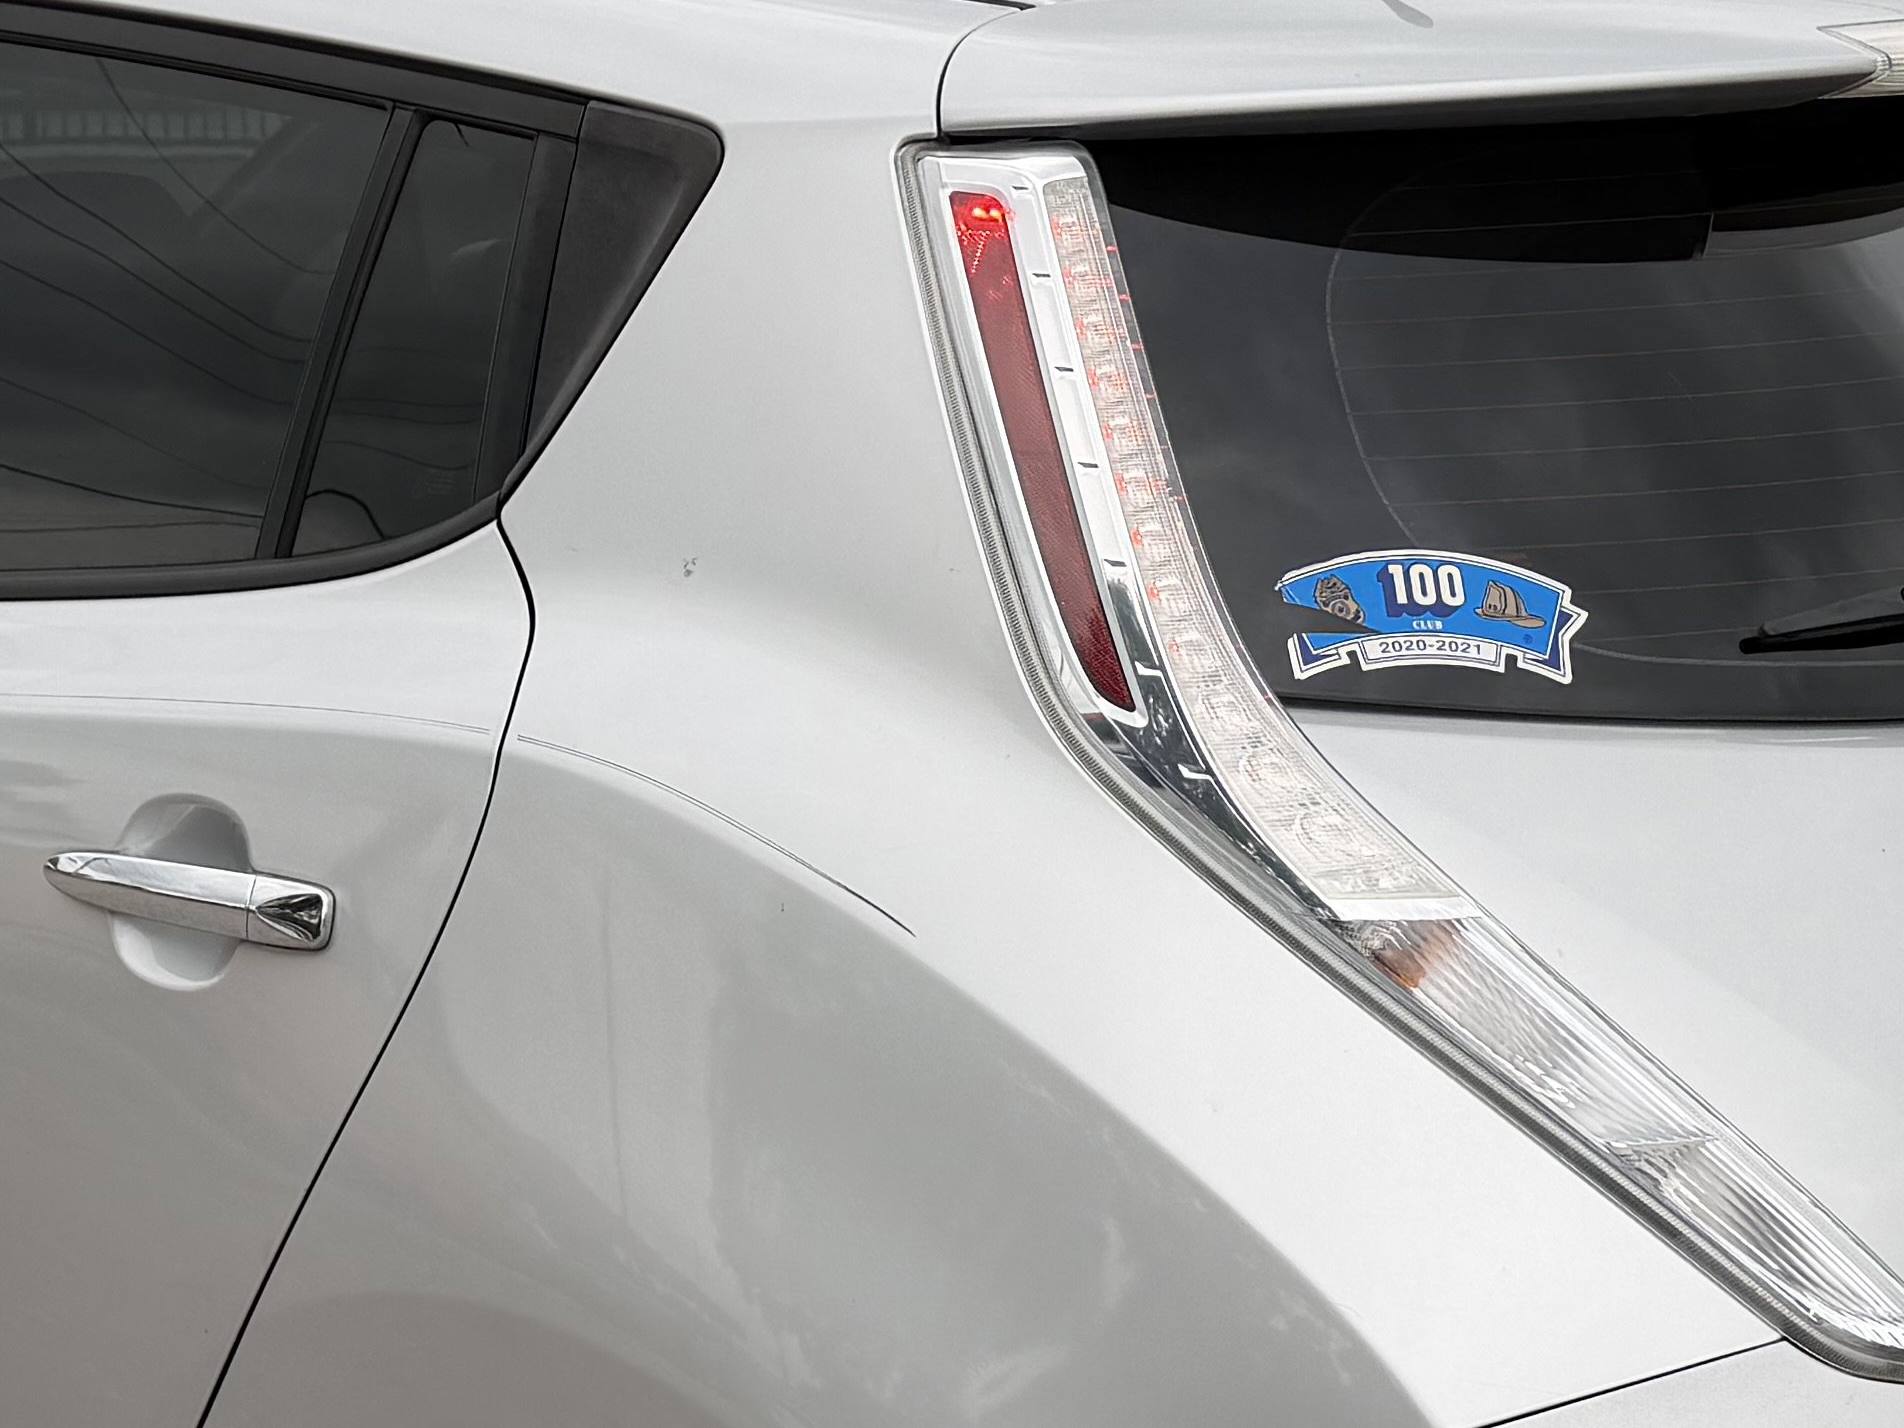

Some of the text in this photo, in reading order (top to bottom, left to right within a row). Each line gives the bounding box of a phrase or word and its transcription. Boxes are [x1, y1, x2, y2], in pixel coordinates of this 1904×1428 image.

[1381, 562, 1465, 613] 100
[1412, 620, 1443, 630] CLUB
[1378, 639, 1482, 655] 2020-2021
